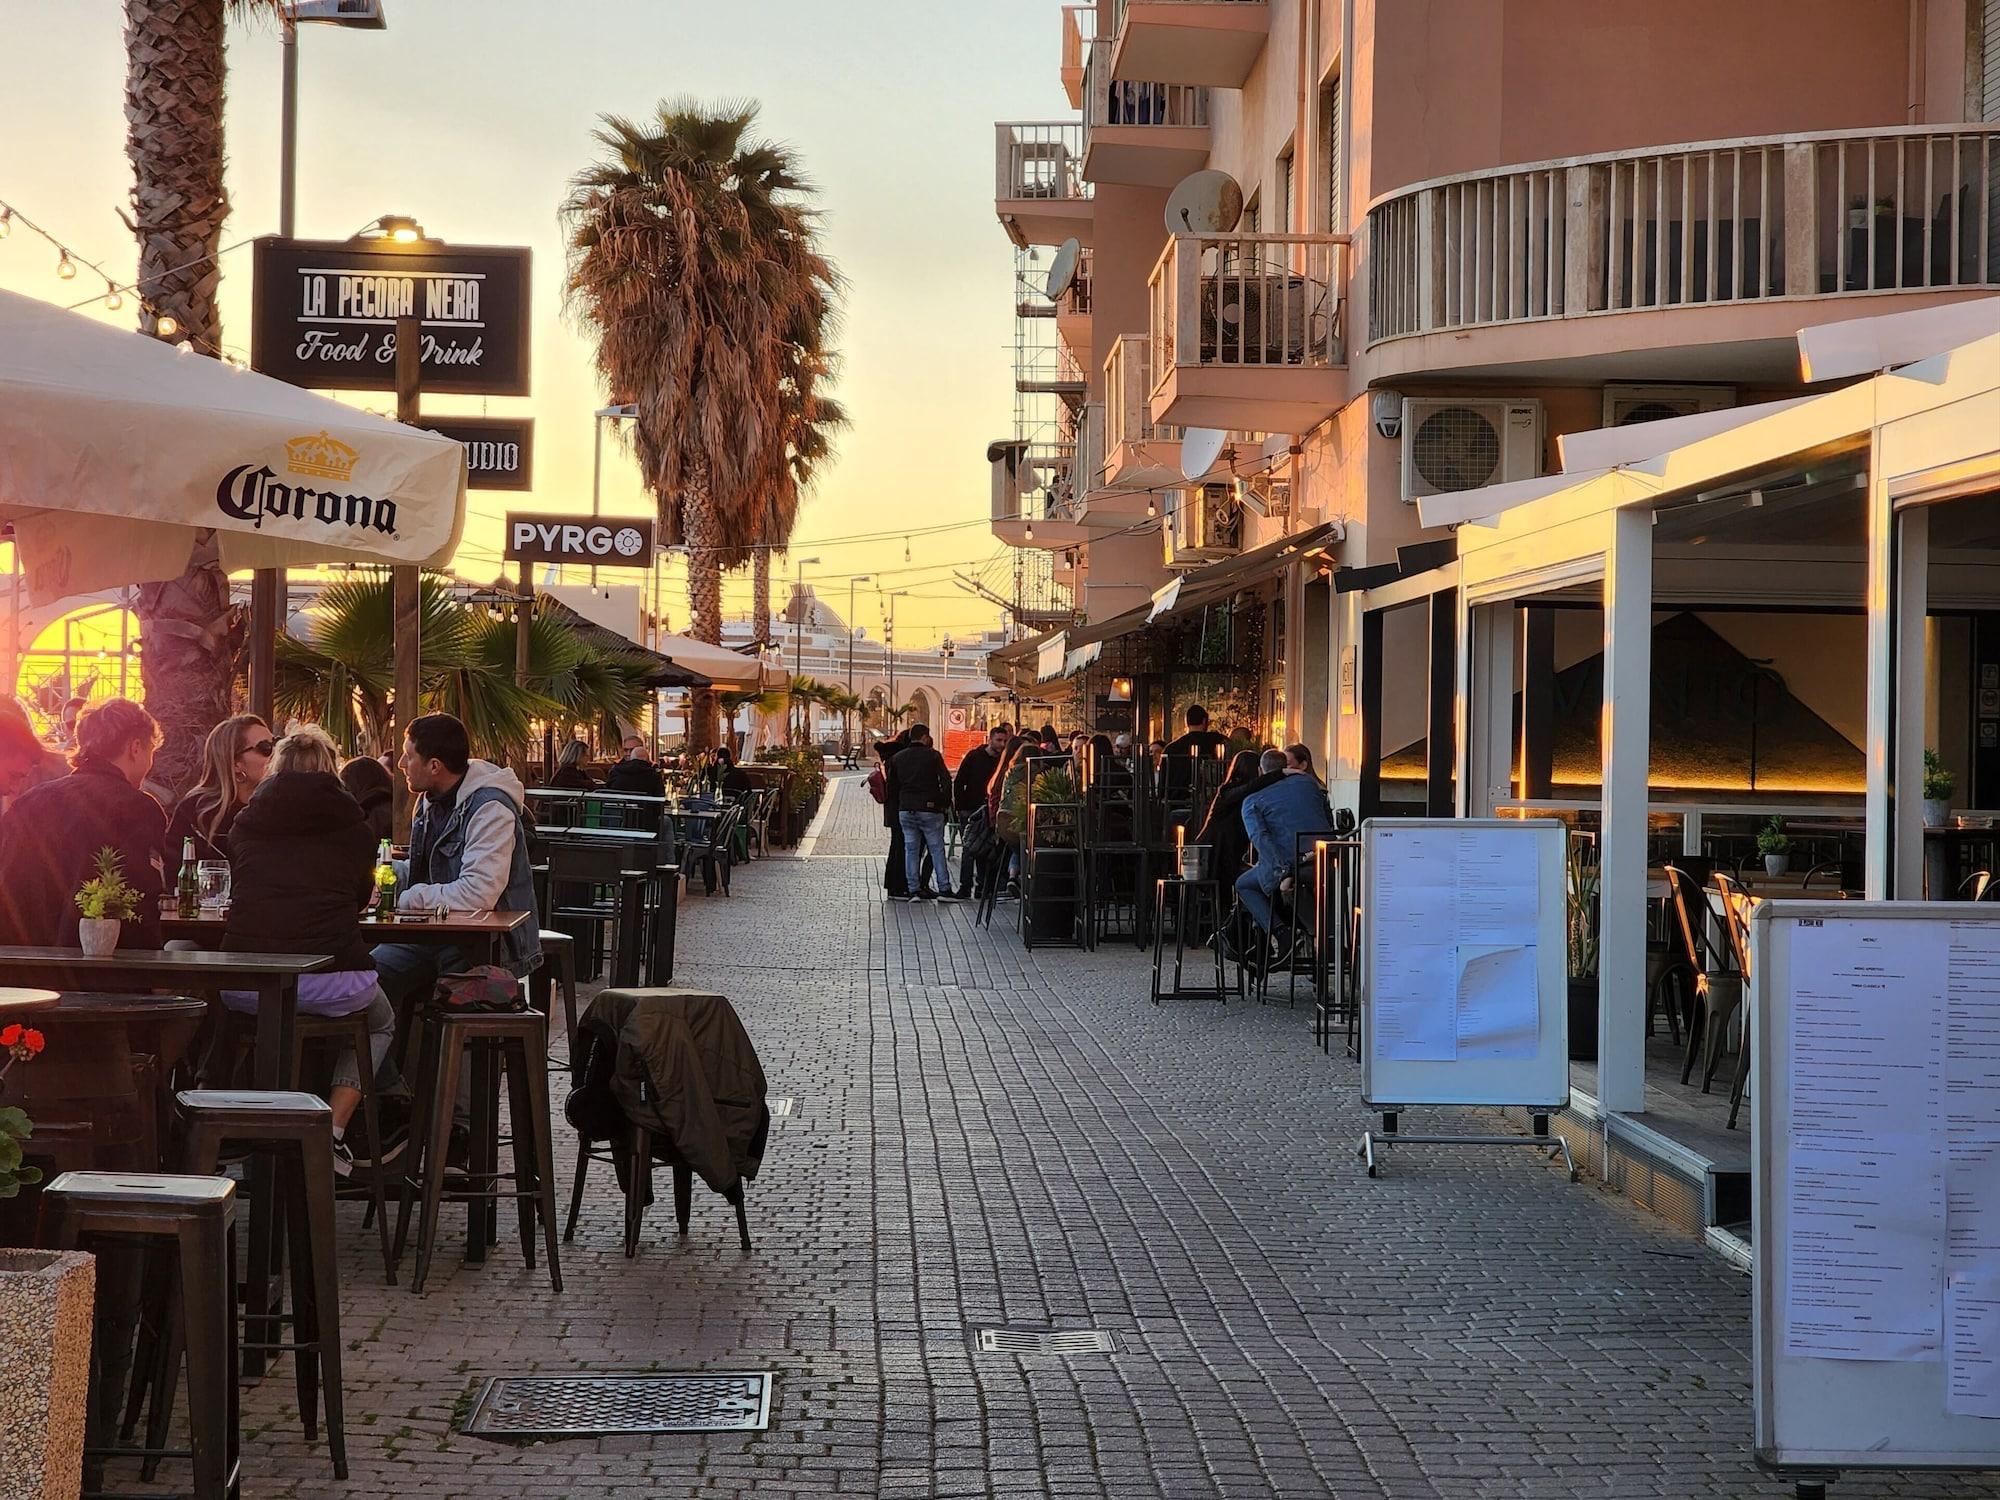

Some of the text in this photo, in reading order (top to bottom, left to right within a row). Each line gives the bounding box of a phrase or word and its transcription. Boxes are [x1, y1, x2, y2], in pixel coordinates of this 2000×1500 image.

[303, 275, 480, 320] LA PECORA NERA
[296, 330, 484, 366] Food & Drink
[464, 441, 519, 471] UDIO
[216, 464, 397, 535] Corona
[513, 522, 643, 556] PYRGO
